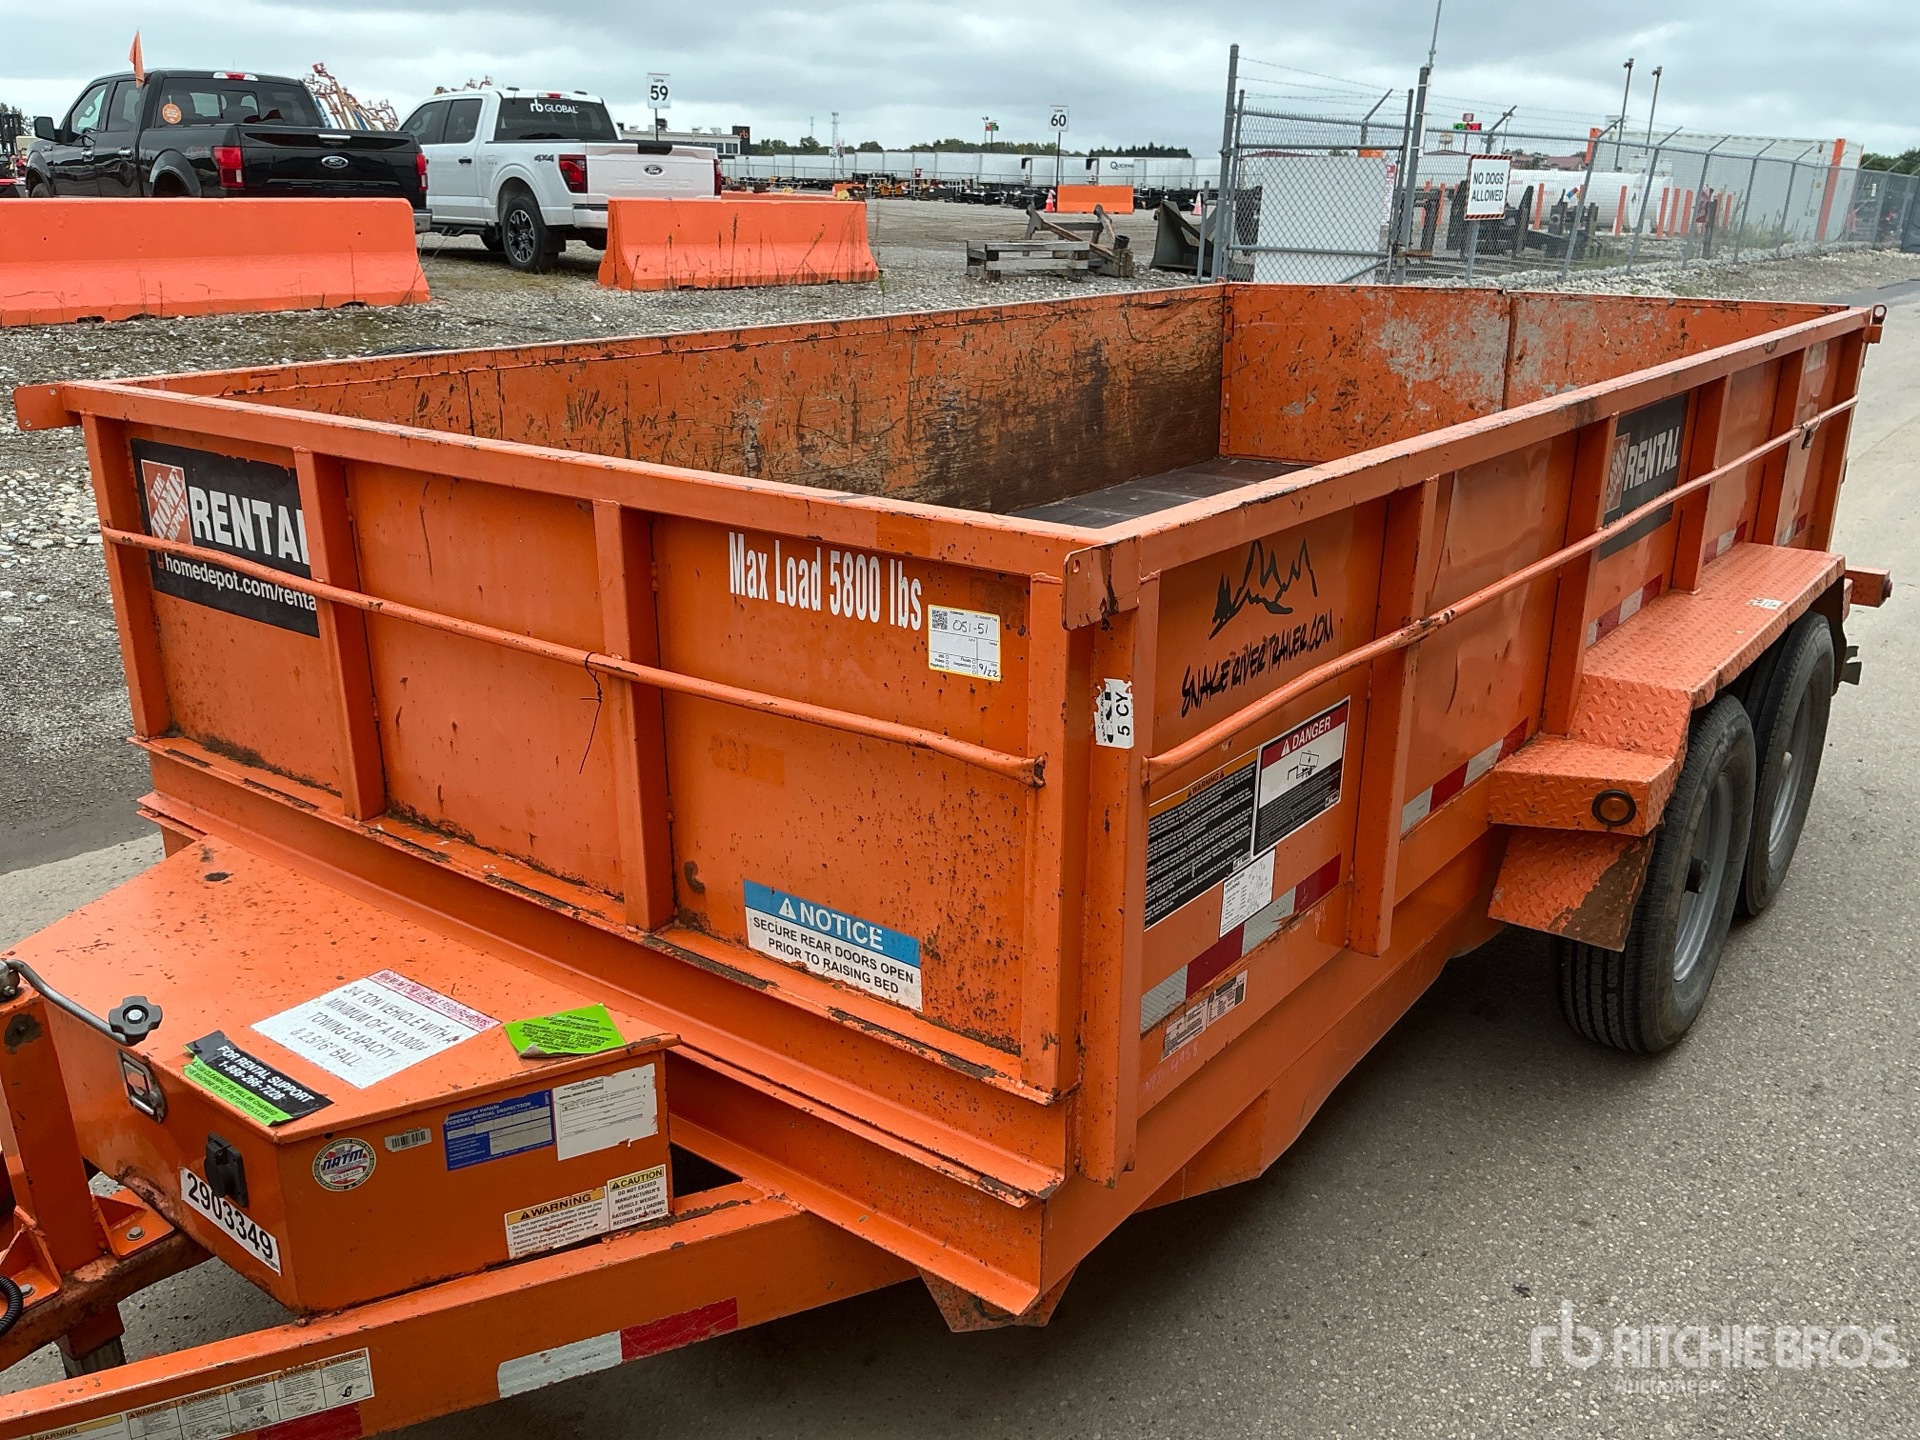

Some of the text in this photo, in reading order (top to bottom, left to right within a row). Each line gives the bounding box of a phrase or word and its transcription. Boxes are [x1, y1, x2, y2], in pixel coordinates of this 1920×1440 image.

[650, 85, 669, 101] 59
[530, 99, 578, 114] rb GLOBAL
[1050, 114, 1067, 127] 60
[1472, 172, 1505, 185] NO DOGS
[1471, 189, 1504, 202] ALLOWED
[1622, 426, 1680, 492] RENTAL
[150, 472, 166, 503] THE
[151, 467, 183, 540] HOME
[728, 531, 923, 632] Max Load 5800 lbs
[1181, 658, 1230, 718] SNAKE
[1115, 691, 1131, 737] 5 CY
[1291, 715, 1332, 749] DANGER
[800, 902, 884, 951] NOTICE
[753, 916, 914, 984] SECURE REAR DOORS OPEN
[768, 937, 899, 994] PRIOR TO RAISING BED
[324, 998, 373, 1023] MINIMUM
[364, 1018, 389, 1030] OF
[377, 1026, 395, 1035] A
[357, 990, 382, 1008] TON
[377, 1001, 426, 1028] VEHICLE
[417, 1021, 452, 1040] WITH
[307, 1011, 400, 1060] TOWING CAPACITY
[329, 1047, 362, 1068] BALL
[216, 1045, 238, 1061] FOR
[235, 1055, 271, 1080] RENTAL
[267, 1075, 315, 1103] SUPPORT
[218, 1059, 287, 1101] 1-888-266-7228
[446, 1101, 532, 1126] FEDERAL ANNUAL INSPECTION
[620, 1168, 662, 1187] CAUTION
[638, 1180, 656, 1190] EXCEED
[530, 1193, 592, 1217] WARNING
[615, 1187, 660, 1204] MANUFACTURER'S
[618, 1193, 658, 1210] VEHICLE WEIGHT
[187, 1172, 274, 1260] 2903349
[549, 1213, 576, 1224] understand
[612, 1208, 633, 1219] RATINGS
[643, 1199, 664, 1210] LOADING
[283, 1363, 316, 1377] WARNING
[330, 1352, 362, 1366] WARNING
[235, 1377, 270, 1390] WARNING
[187, 1390, 221, 1403] WARNING
